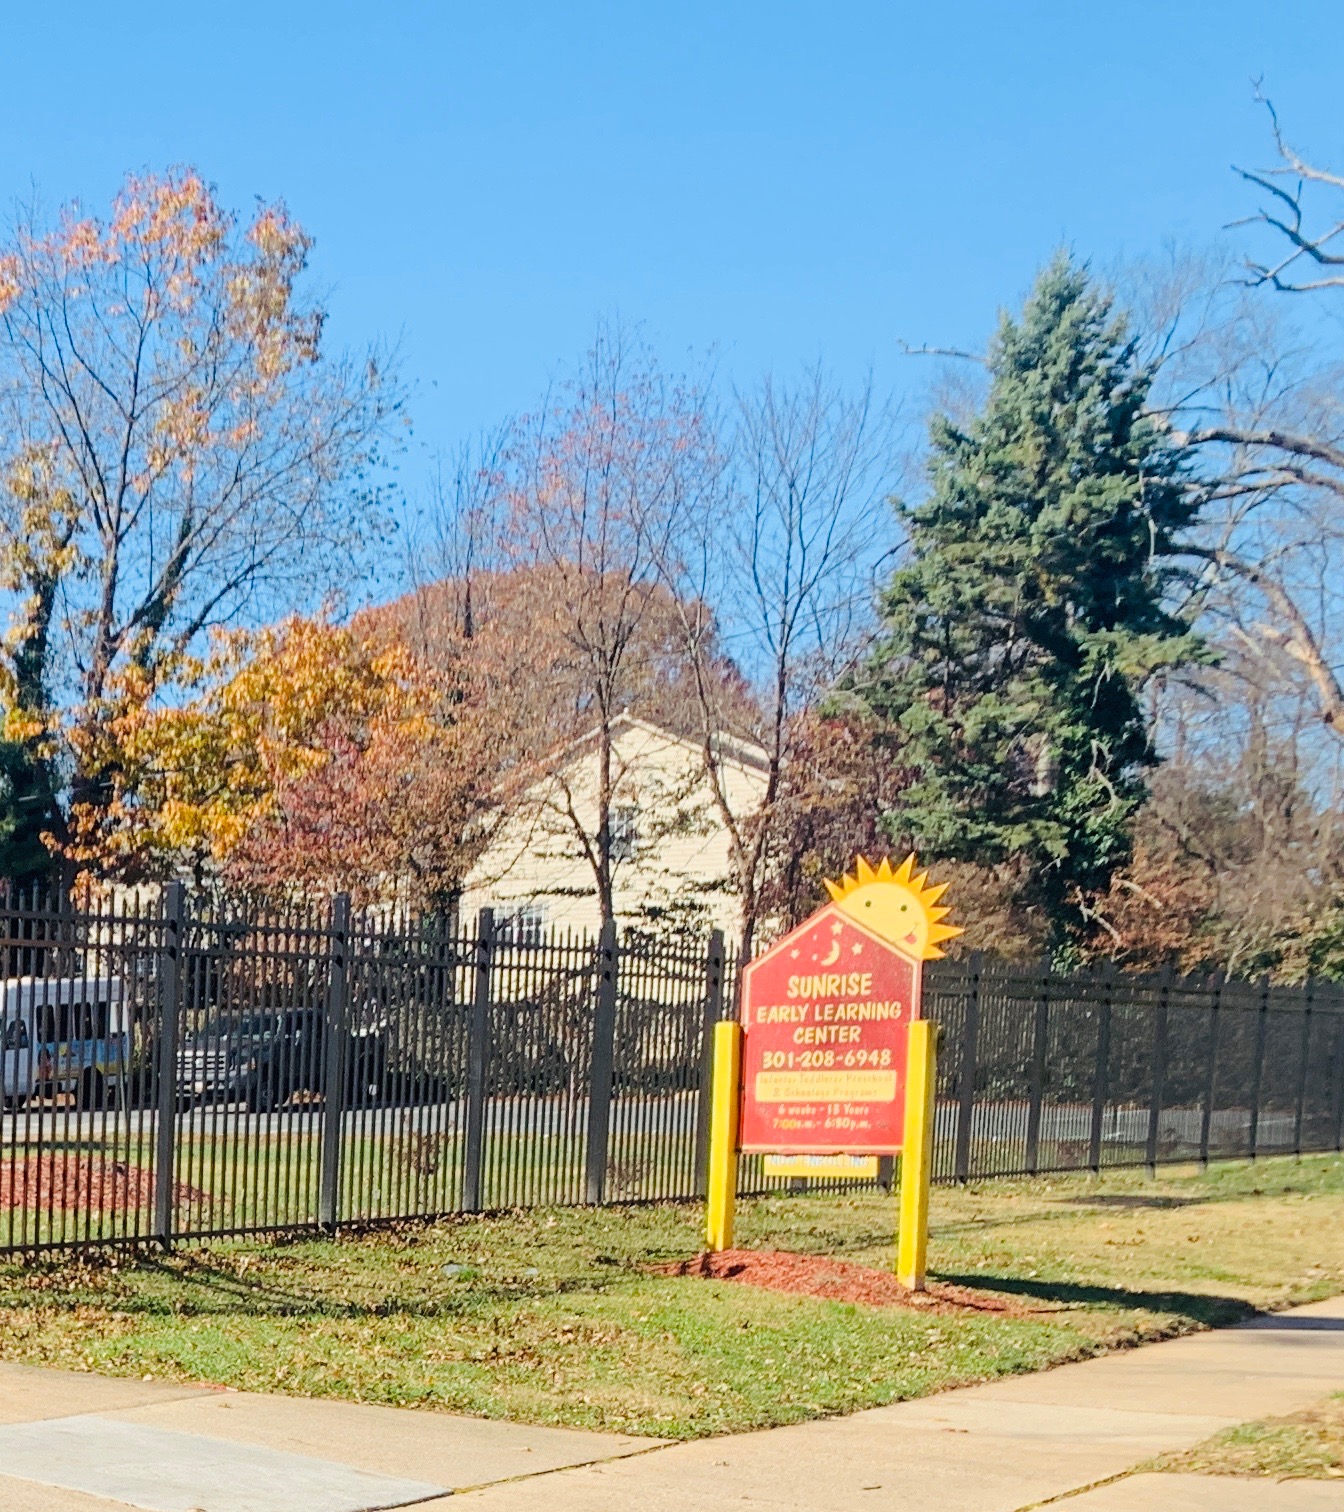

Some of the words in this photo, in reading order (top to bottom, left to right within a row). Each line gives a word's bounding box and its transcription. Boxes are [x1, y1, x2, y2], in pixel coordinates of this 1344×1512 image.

[786, 972, 873, 1000] SUNRISE
[756, 1003, 810, 1024] EARLY
[814, 1001, 902, 1022] LEARNING
[793, 1025, 862, 1045] CENTER
[762, 1048, 892, 1069] 301-208-6948
[833, 1087, 878, 1099] Programs
[778, 1103, 786, 1115] 6
[788, 1103, 817, 1115] weeks
[843, 1102, 869, 1115] Years
